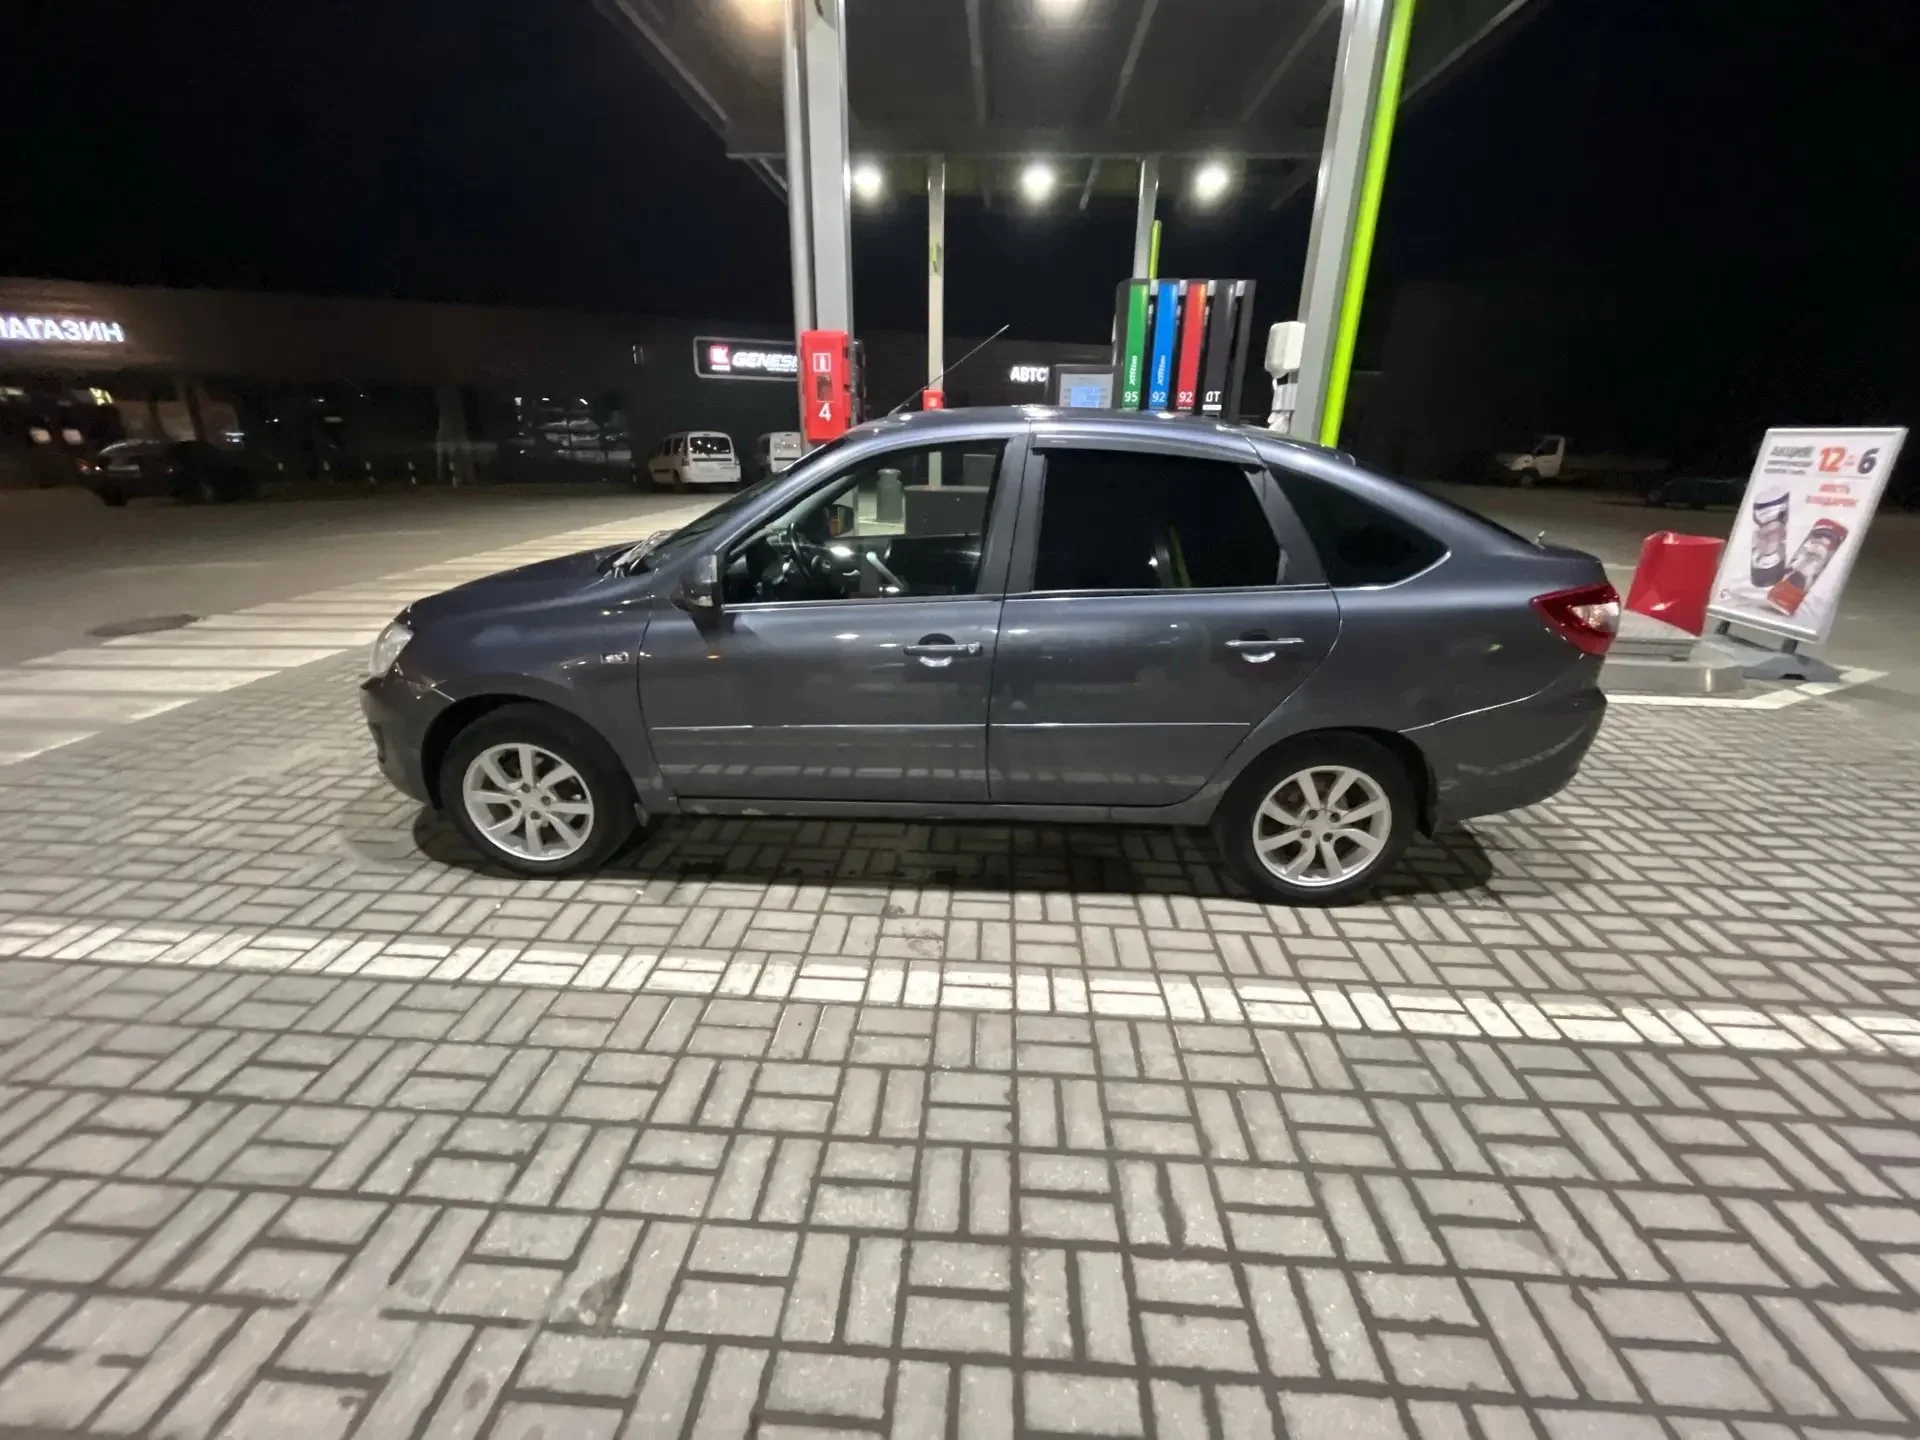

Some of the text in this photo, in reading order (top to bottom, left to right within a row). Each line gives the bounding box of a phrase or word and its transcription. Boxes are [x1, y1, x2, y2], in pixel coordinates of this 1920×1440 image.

[0, 315, 125, 342] АГАЗИН
[732, 351, 798, 368] GENESI
[1124, 391, 1139, 403] 95
[1152, 391, 1166, 403] 92
[1179, 391, 1193, 403] 92
[818, 402, 832, 422] 4
[1819, 446, 1846, 472] 12
[1857, 447, 1880, 475] 6
